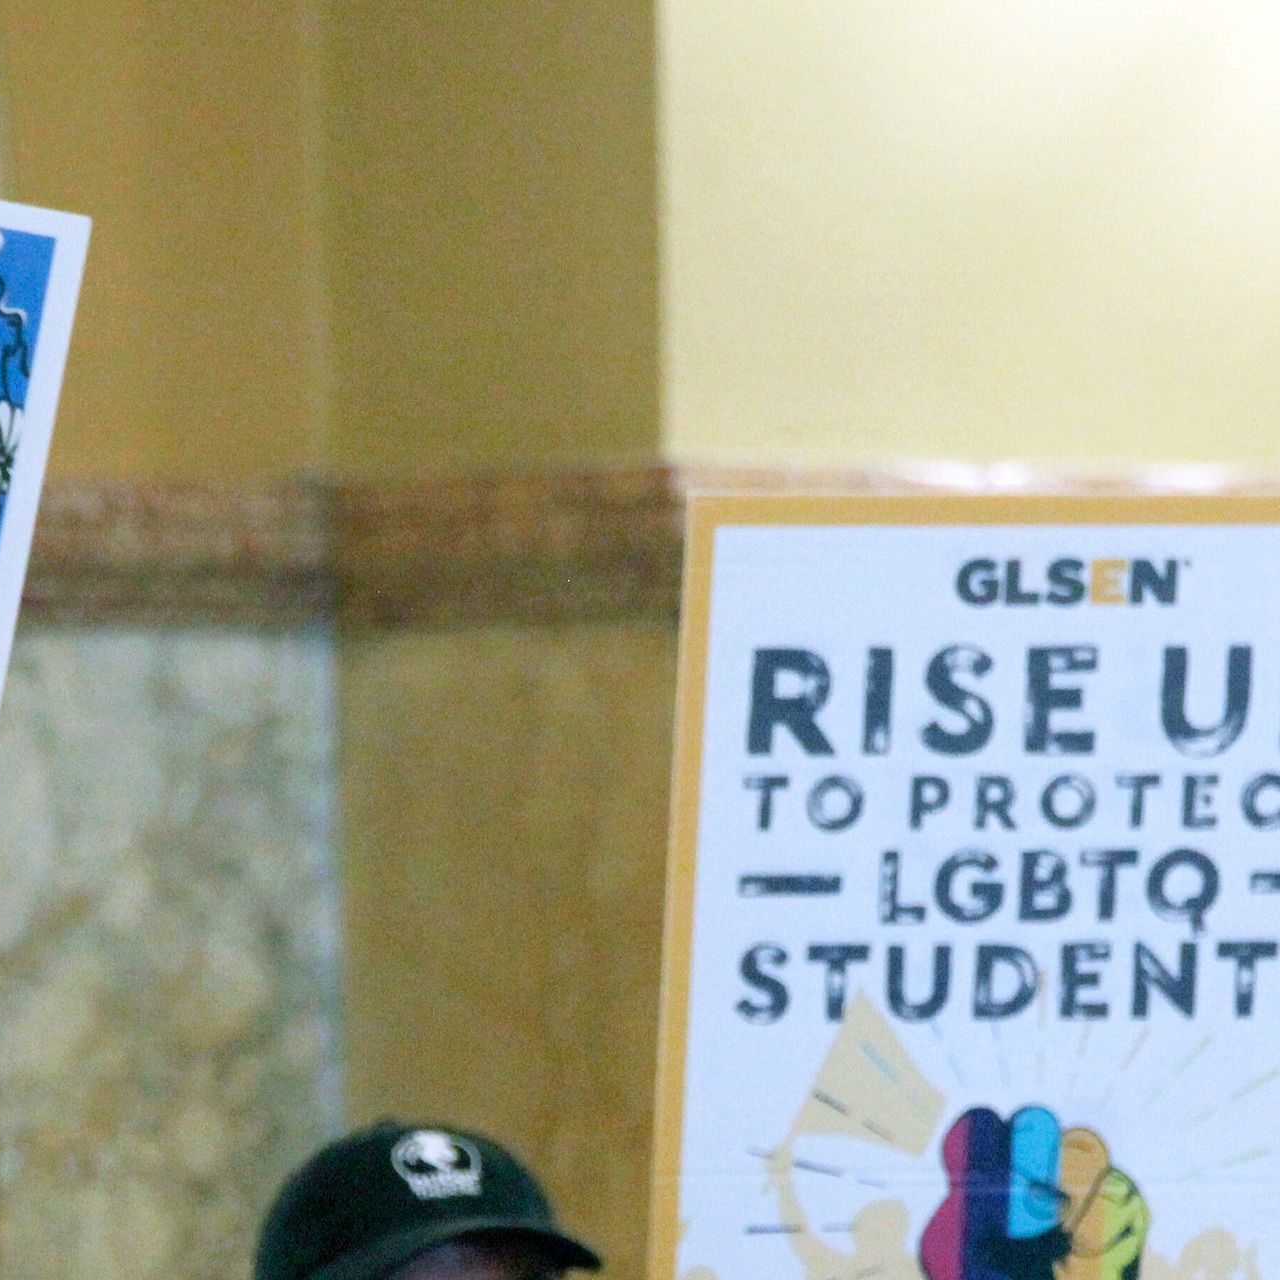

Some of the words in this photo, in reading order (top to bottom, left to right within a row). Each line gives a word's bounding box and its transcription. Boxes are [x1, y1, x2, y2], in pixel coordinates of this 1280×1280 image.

[955, 557, 1180, 607] GLSEN
[746, 643, 1100, 757] RISE
[743, 774, 865, 832] TO
[878, 847, 1223, 937] LGBTQ
